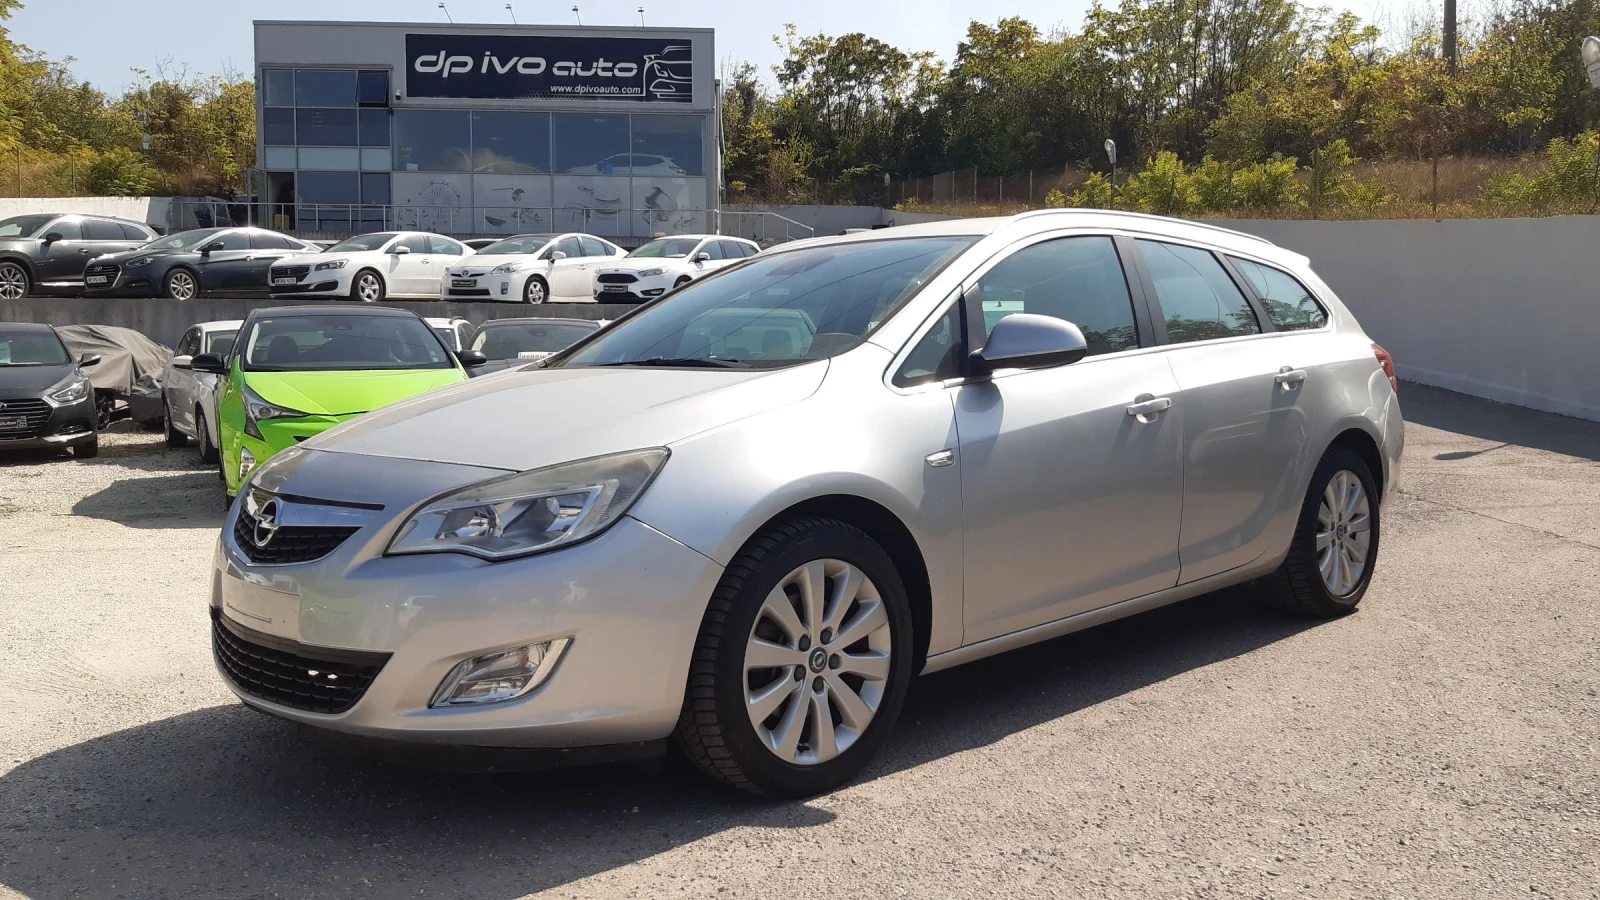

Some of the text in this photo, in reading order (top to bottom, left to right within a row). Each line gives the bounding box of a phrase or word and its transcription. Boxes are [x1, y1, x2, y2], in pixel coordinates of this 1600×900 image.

[415, 50, 638, 78] dp ivo auto
[550, 84, 641, 95] www.dpivoauto.com
